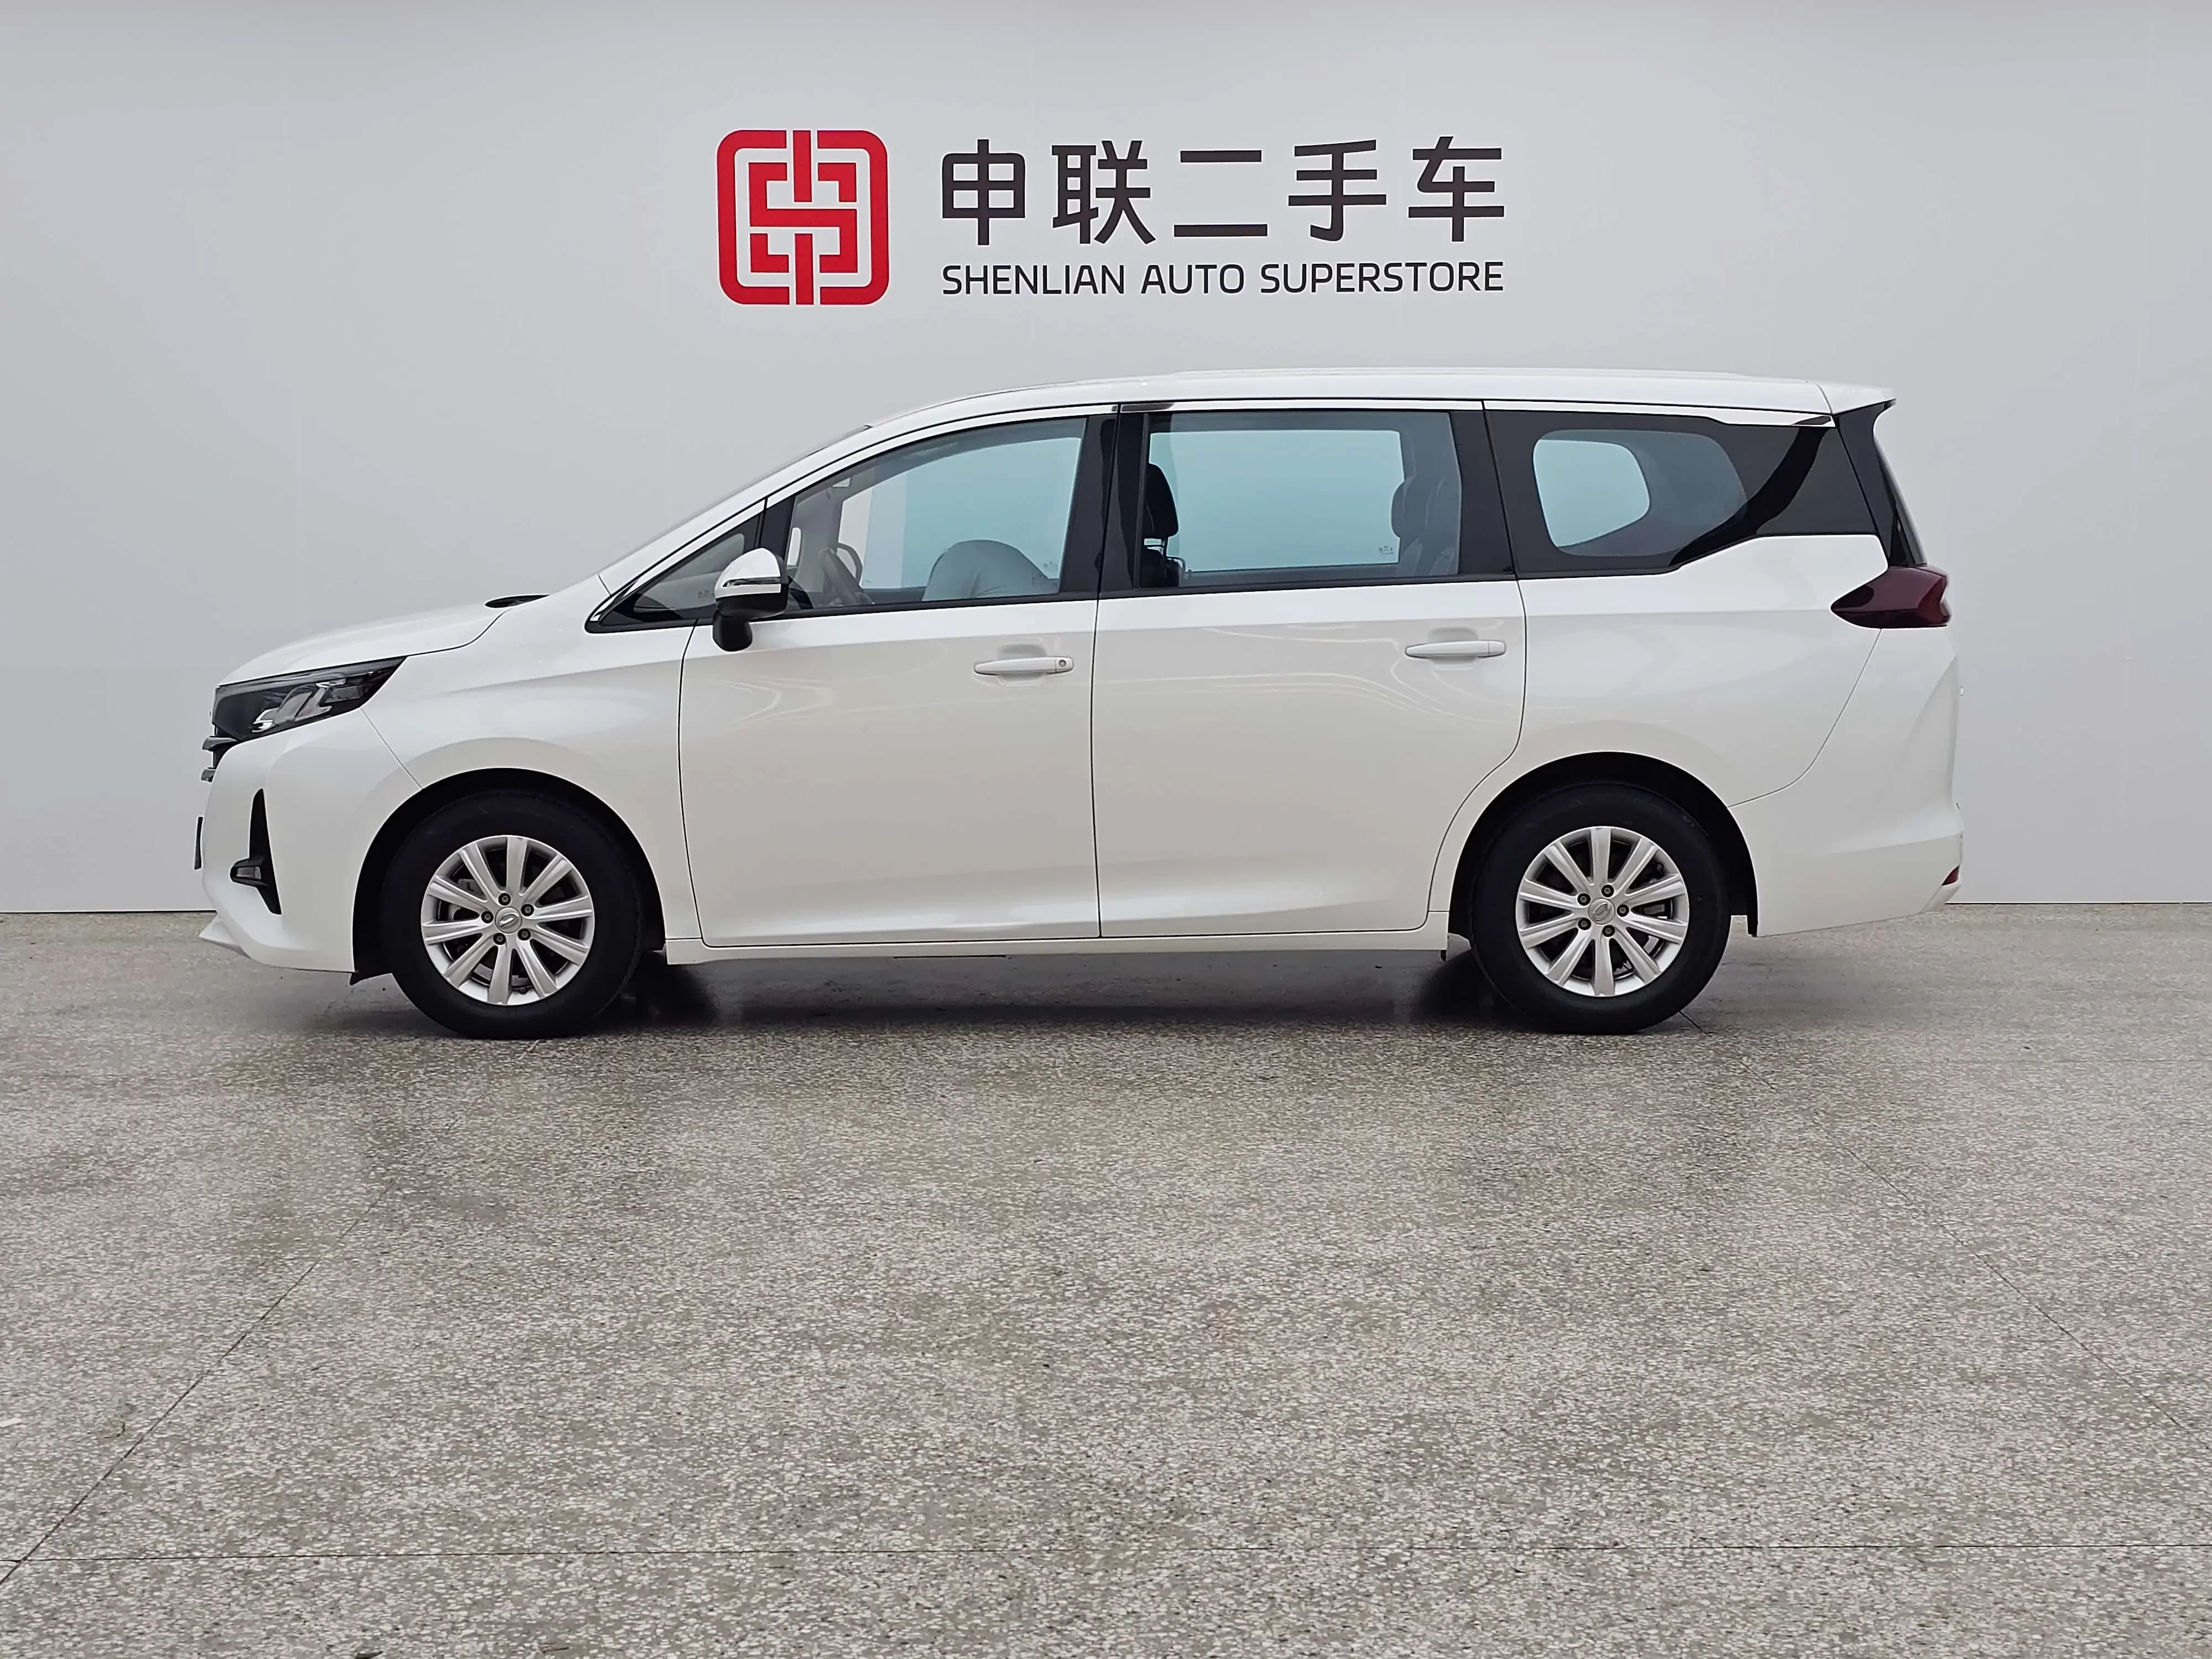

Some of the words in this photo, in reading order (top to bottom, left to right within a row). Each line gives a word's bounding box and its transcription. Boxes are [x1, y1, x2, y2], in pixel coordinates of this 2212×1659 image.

[942, 136, 1505, 246] 申联二手车
[943, 264, 1124, 295] SHENLIAN
[1141, 264, 1244, 294] AUTO
[1261, 262, 1504, 293] SUPERSTORE
